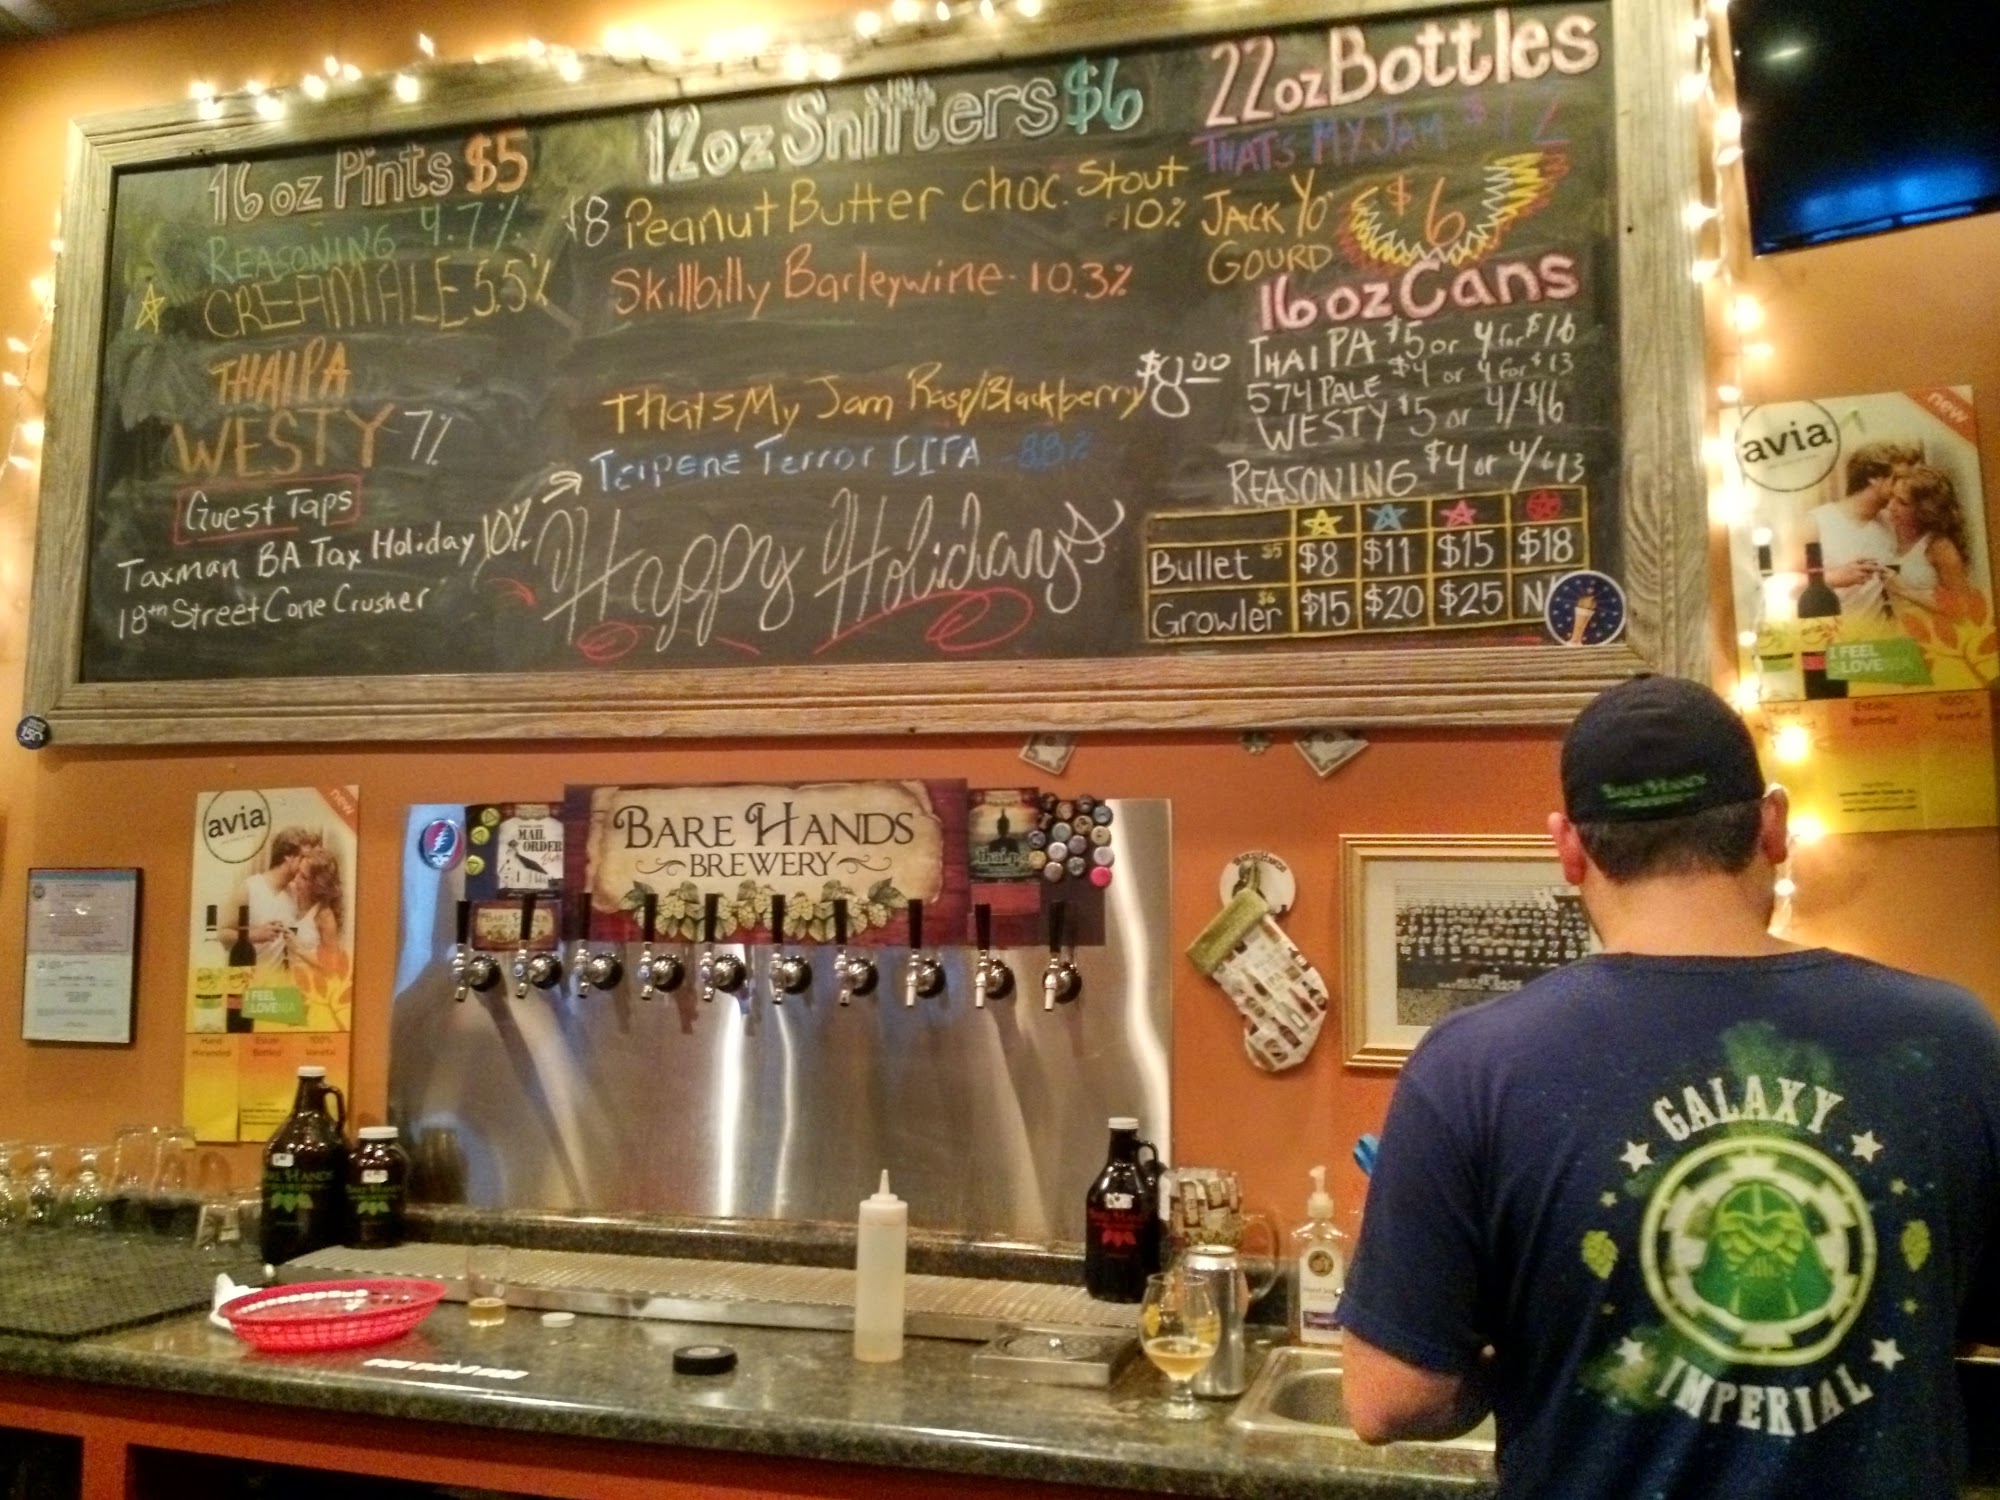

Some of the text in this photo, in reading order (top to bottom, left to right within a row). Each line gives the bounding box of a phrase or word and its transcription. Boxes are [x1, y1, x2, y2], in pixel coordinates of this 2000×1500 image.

[1329, 7, 1601, 107] Bottles
[782, 77, 1060, 167] Snifters
[1062, 57, 1144, 134] $6
[334, 146, 455, 209] Pints
[465, 127, 529, 194] $5
[623, 190, 780, 250] Peanut
[787, 177, 946, 234] Butter
[1075, 155, 1191, 199] Stout
[1201, 189, 1286, 238] JACK
[206, 223, 396, 286] REASONING
[1207, 240, 1333, 285] GOURD
[1028, 261, 1135, 303] 10.3%
[1400, 253, 1580, 321] Cans
[1430, 339, 1460, 355] or
[1474, 320, 1495, 361] 4
[1499, 323, 1526, 348] for
[804, 374, 894, 421] Jam
[1246, 382, 1314, 417] 574
[1319, 373, 1383, 403] PALE
[1443, 367, 1465, 384] or
[1476, 359, 1493, 385] 4
[1498, 356, 1527, 380] for
[1926, 388, 1970, 427] new
[169, 403, 396, 479] WESTY
[1256, 401, 1390, 453] WESTY
[1445, 407, 1472, 430] or
[1742, 418, 1834, 465] avia
[753, 433, 876, 476] Terror
[1227, 457, 1419, 508] REASONING
[1474, 454, 1500, 477] or
[185, 488, 353, 533] Guest Taps
[117, 558, 240, 594] Taxman
[257, 540, 302, 579] BA
[309, 536, 362, 570] Tax
[371, 521, 477, 568] Holiday
[1149, 548, 1254, 588] Bullet
[1299, 541, 1339, 578] $8
[1362, 535, 1414, 577] $11
[1437, 528, 1497, 570] $15
[1517, 526, 1575, 566] $18
[170, 598, 261, 631] Street
[263, 585, 326, 623] Cone
[333, 582, 432, 614] Crusher
[1151, 598, 1283, 638] Growler
[1299, 587, 1351, 628] $15
[1364, 582, 1425, 623] $20
[1438, 580, 1504, 617] $25
[1839, 643, 1880, 659] FEEL
[207, 804, 267, 839] avia
[517, 828, 546, 841] MAIL
[523, 840, 564, 852] ORDER
[613, 801, 915, 850] BARE HANDS
[689, 851, 839, 879] BREWERY
[251, 989, 277, 1002] FEEL
[1652, 1074, 1845, 1142] GALAXY
[1655, 1355, 1875, 1438] IMPERIAL
